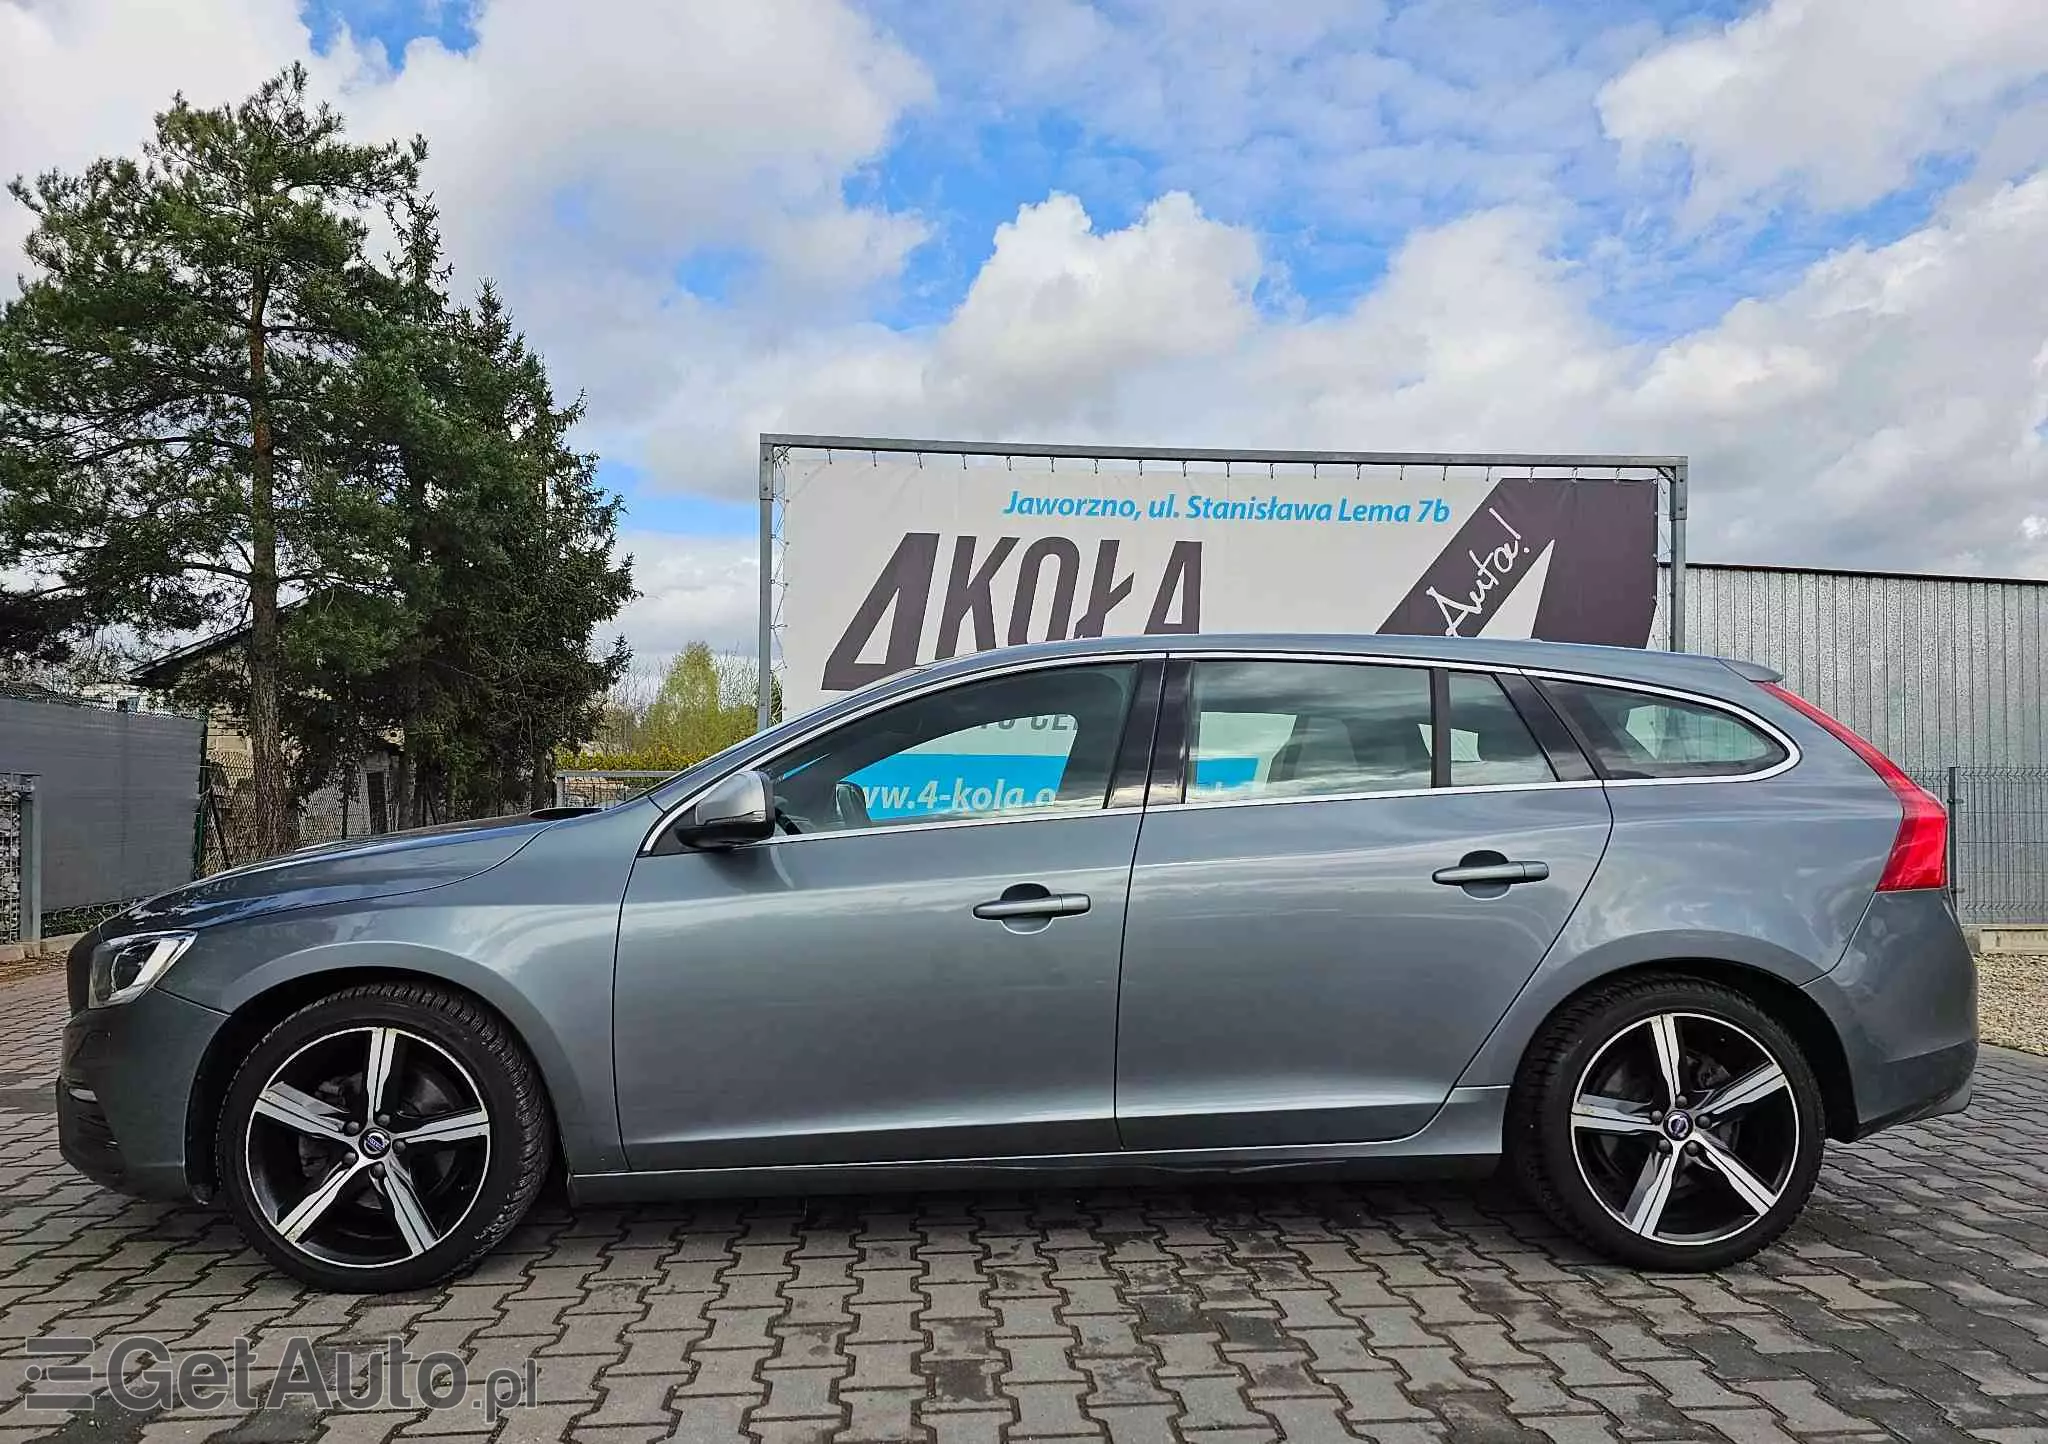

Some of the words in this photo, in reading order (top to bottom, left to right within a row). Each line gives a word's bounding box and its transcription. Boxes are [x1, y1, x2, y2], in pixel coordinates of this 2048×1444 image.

[1003, 490, 1142, 521] Jaworzno,
[1149, 494, 1180, 518] ul.
[1185, 495, 1332, 521] Stanisława
[1338, 498, 1411, 522] Lema
[1416, 500, 1450, 522] 7b
